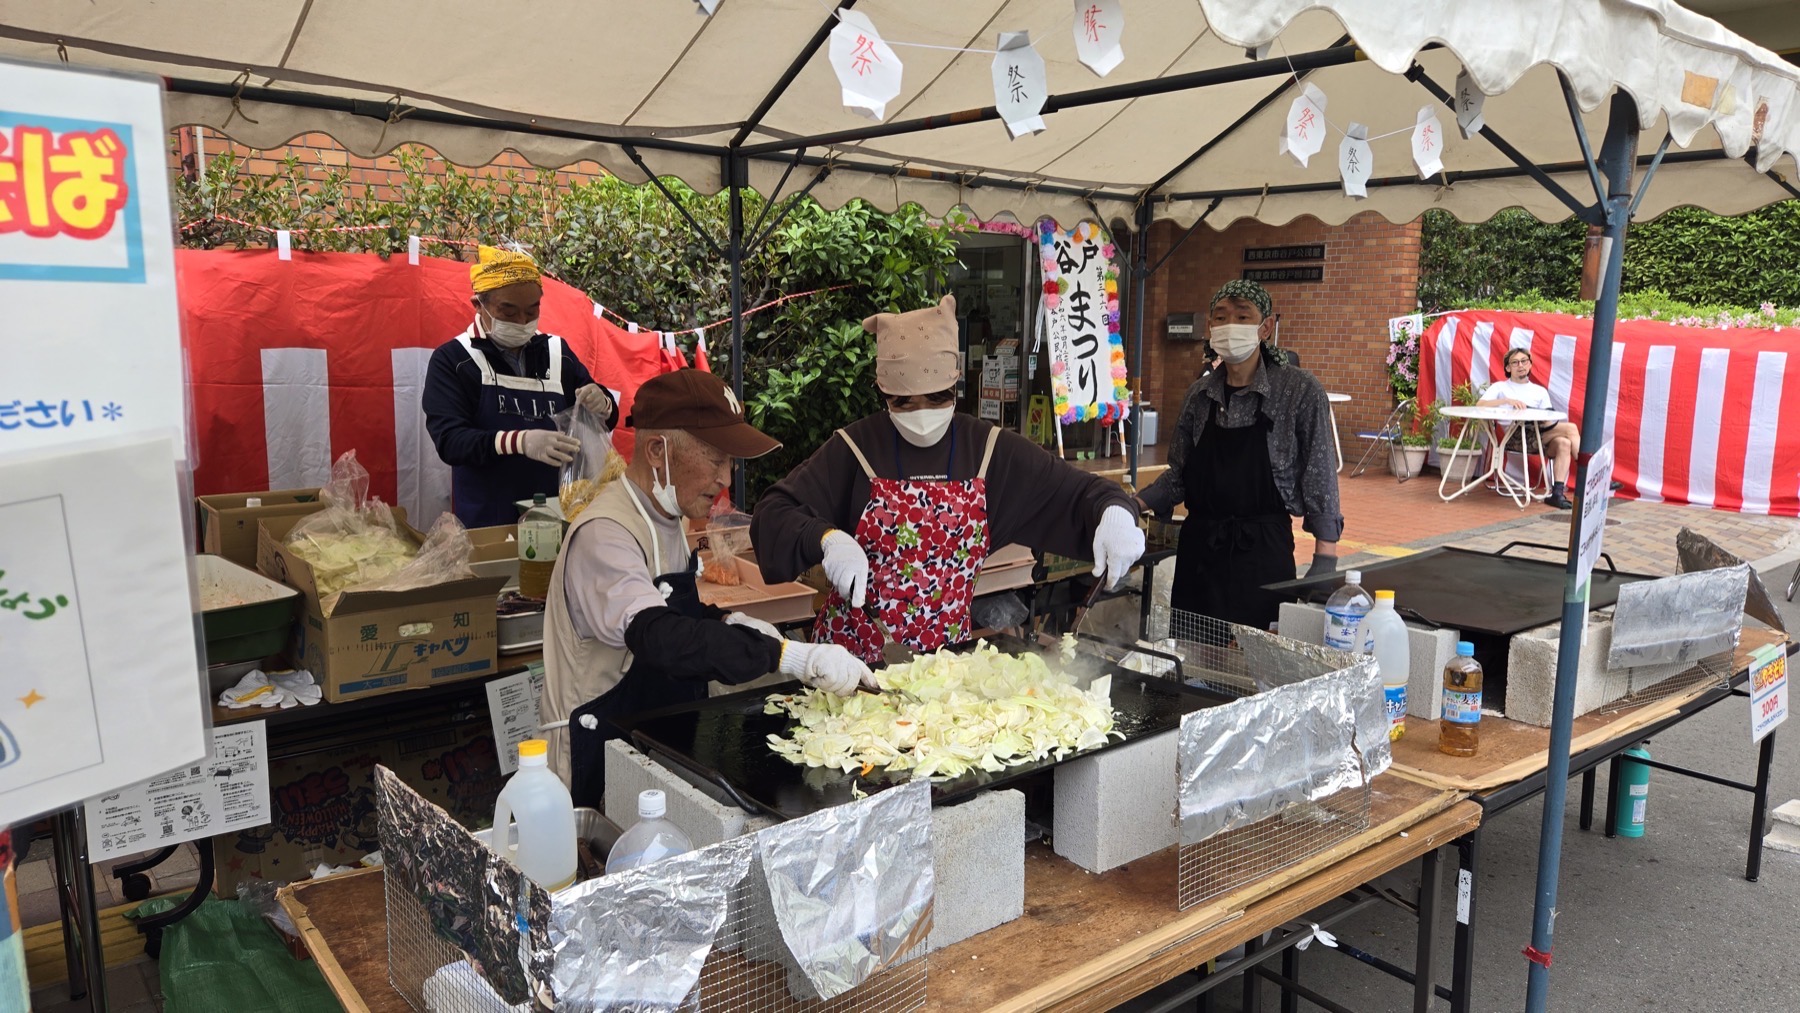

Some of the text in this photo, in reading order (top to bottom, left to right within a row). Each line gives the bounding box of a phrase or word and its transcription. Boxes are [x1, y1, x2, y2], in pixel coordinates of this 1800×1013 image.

[1083, 4, 1107, 43] 祭
[850, 33, 882, 77] 祭
[1007, 64, 1029, 104] 祭
[1294, 106, 1316, 142] 祭
[1420, 124, 1435, 153] 祭
[1346, 146, 1361, 175] 祭
[1095, 265, 1110, 326] 第三十六回
[1053, 239, 1100, 407] 谷戸 まつり
[498, 394, 558, 417] ELLE
[360, 611, 470, 642] 愛 知
[413, 635, 470, 657] キャベツ
[1461, 693, 1479, 705] 麦茶
[1761, 694, 1779, 718] 300円
[286, 802, 349, 825] HALLOWEEN
[297, 820, 336, 837] HAPPY
